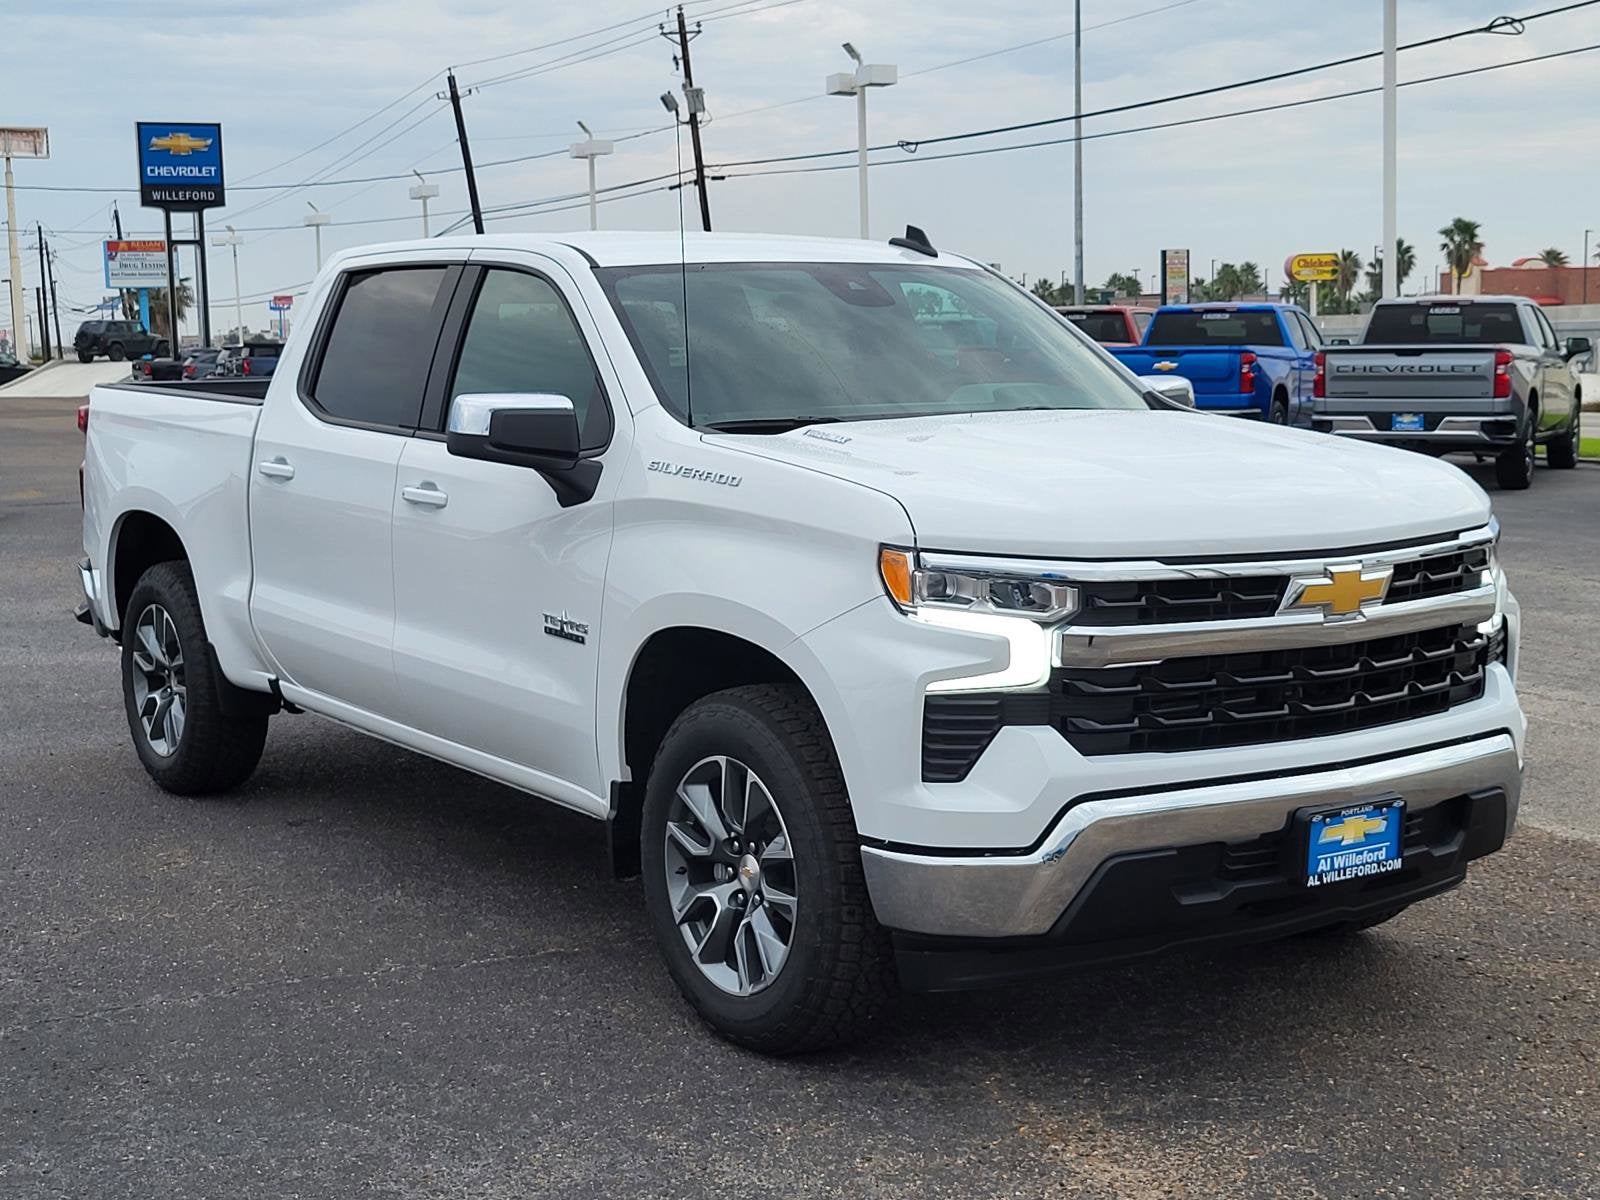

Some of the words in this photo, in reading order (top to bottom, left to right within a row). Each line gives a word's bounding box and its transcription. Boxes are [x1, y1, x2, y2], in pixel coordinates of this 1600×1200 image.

[147, 166, 217, 177] CHEVROLET
[151, 190, 216, 201] WILLEFORD
[1336, 364, 1481, 374] CHEVROLET
[647, 460, 743, 487] SILVERADO
[1341, 806, 1373, 816] PORTLAND
[1334, 847, 1386, 869] Willeford
[1307, 874, 1321, 888] AL
[1322, 858, 1402, 884] WILLEFORD.COM
